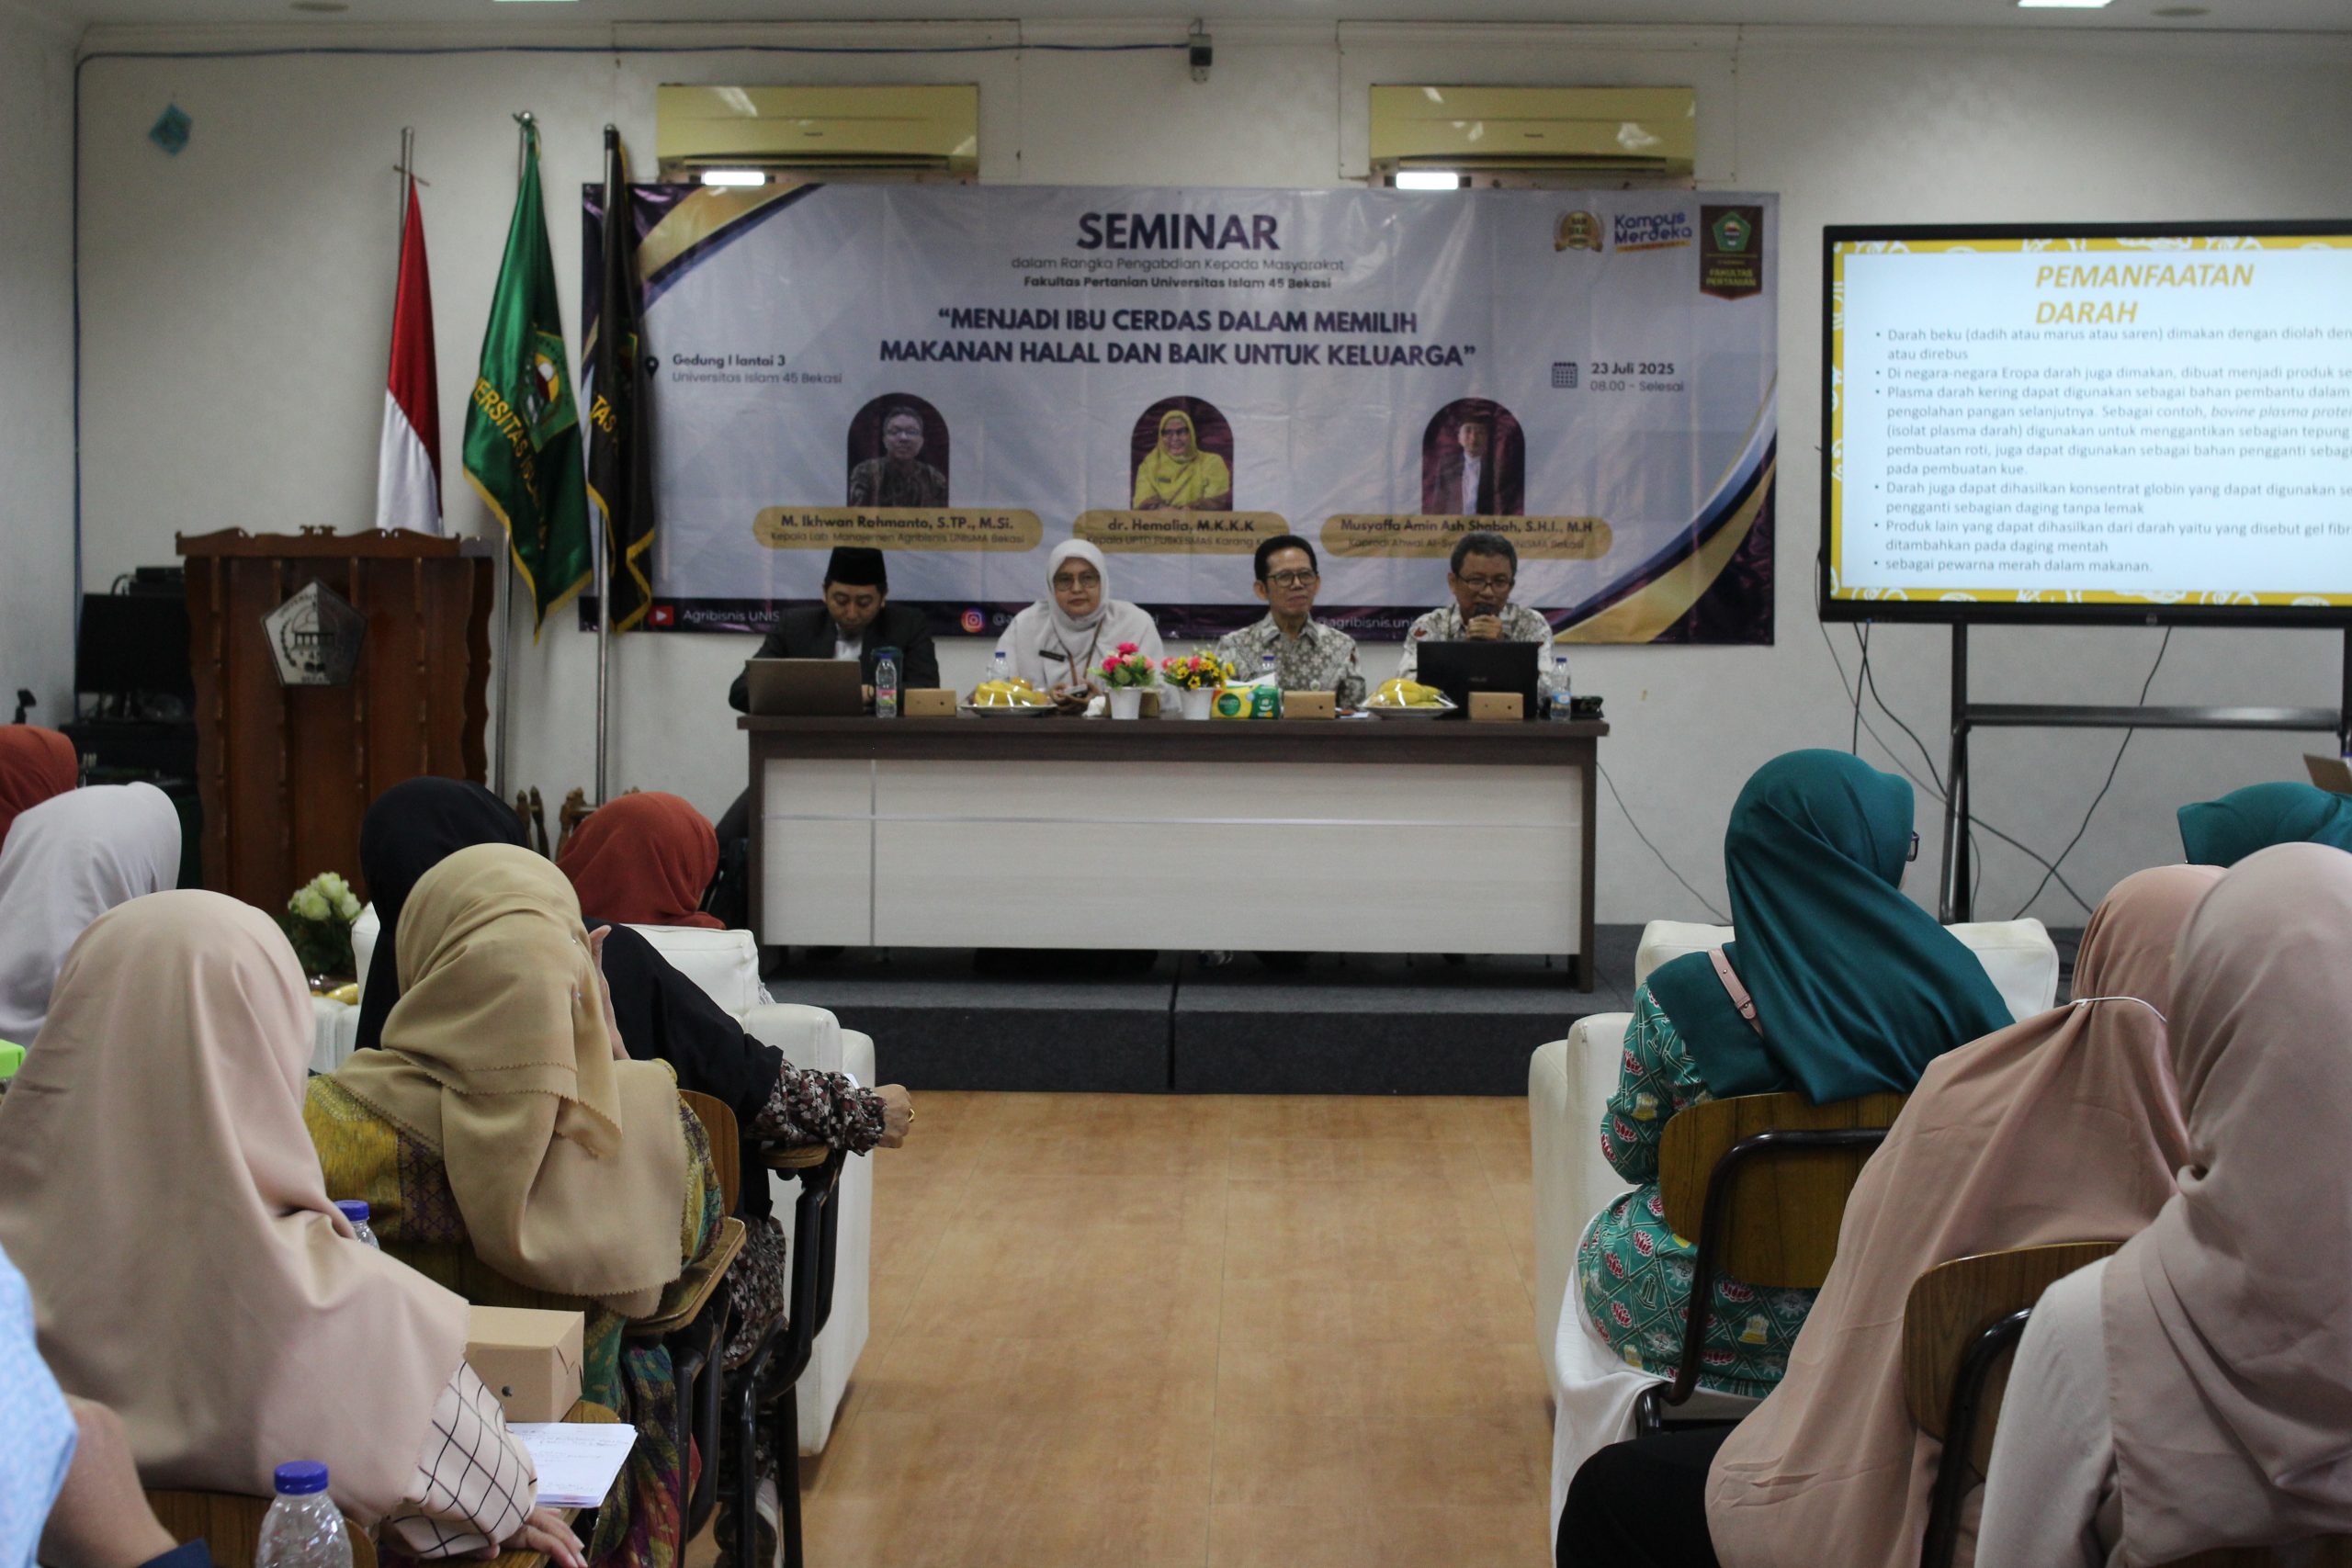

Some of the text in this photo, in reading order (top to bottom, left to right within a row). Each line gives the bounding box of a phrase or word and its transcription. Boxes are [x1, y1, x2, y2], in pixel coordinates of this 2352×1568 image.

[1614, 210, 1686, 229] Kampus
[1076, 212, 1280, 251] SEMINAR
[1614, 225, 1692, 244] Merdeka
[1011, 256, 1344, 274] dalam Rangka Pengabdian Kepada Masyarakat
[1023, 276, 1332, 289] Fakultas Pertanian Universitas Islam 45 Bekasi
[2035, 264, 2255, 288] PEMANFAATAN
[2035, 301, 2138, 324] DARAH
[1067, 309, 1106, 331] IBU
[1113, 310, 1212, 332] CERDAS
[1219, 310, 1307, 333] DALAM
[1314, 311, 1418, 333] MEMILIH
[1888, 327, 2323, 341] Darah beku (dadih atau marus atau saren) dimakan dengan diolah
[673, 354, 724, 368] Gedung
[735, 355, 775, 367] lantai
[777, 355, 786, 367] 3
[879, 340, 1013, 362] MAKANAN
[1020, 341, 1100, 363] HALAL
[1108, 343, 1161, 364] DAN
[1169, 343, 1227, 365] BAIK
[1234, 343, 1320, 366] UNTUK
[1888, 349, 1967, 359] atau direbus
[1591, 362, 1675, 376] 23 Juli 2025
[1888, 367, 1901, 379] Di
[1905, 369, 1997, 382] negara-negara
[2002, 367, 2039, 380] Eropa
[2043, 367, 2081, 378] darah
[2086, 368, 2112, 381] juga
[2181, 367, 2222, 378] dibuat
[2228, 367, 2282, 380] menjadi
[2287, 366, 2334, 379] produk
[673, 372, 842, 384] Universitas Islam 45 Bekasi
[1590, 380, 1684, 392] 08.00 Selesai
[1888, 386, 2349, 400] Plasma darah kering dapat digunakan sebagai bahan pembantu dalam
[1887, 405, 1963, 421] pengolahan
[1967, 407, 2015, 421] pangan
[2102, 404, 2153, 421] Sebagai
[2211, 405, 2256, 418] bovine
[2259, 405, 2309, 420] plasma
[1887, 424, 2349, 440] (isolat plasma darah) digunakan untuk menggantikan sebagian tepung
[1887, 444, 1961, 457] pembuatan
[1995, 445, 2022, 459] juga
[2026, 444, 2064, 457] dapat
[2068, 444, 2136, 459] digunakan
[2140, 444, 2189, 459] sebagai
[2194, 444, 2235, 457] bahan
[2239, 445, 2306, 460] pengganti
[1887, 463, 1918, 476] pada
[1922, 463, 1996, 476] pembuatan
[1887, 481, 2335, 498] Darah juga dapat dihasilkan konsentrat globin yang dapat digunakan
[1886, 501, 2144, 517] pengganti sebagian daging tanpa lemak
[781, 515, 797, 527] M.
[802, 515, 854, 528] Ikhwan
[857, 515, 933, 530] Rahmanto,
[1108, 519, 1128, 531] dr.
[1197, 520, 1254, 532] M.K.K.K
[1340, 518, 1401, 534] Musyaffa
[1404, 518, 1438, 532] Amin
[1441, 519, 1464, 532] Ash
[1886, 520, 2324, 537] Produk lain yang dapat dihasilkan dari darah yaitu yang disebut gel
[1885, 538, 2108, 555] ditambahkan pada daging mentah
[1885, 558, 1934, 572] sebagai
[1938, 560, 1995, 572] pewarna
[1998, 559, 2041, 571] merah
[2044, 558, 2085, 572] dalam
[683, 610, 745, 623] Agribisnis
